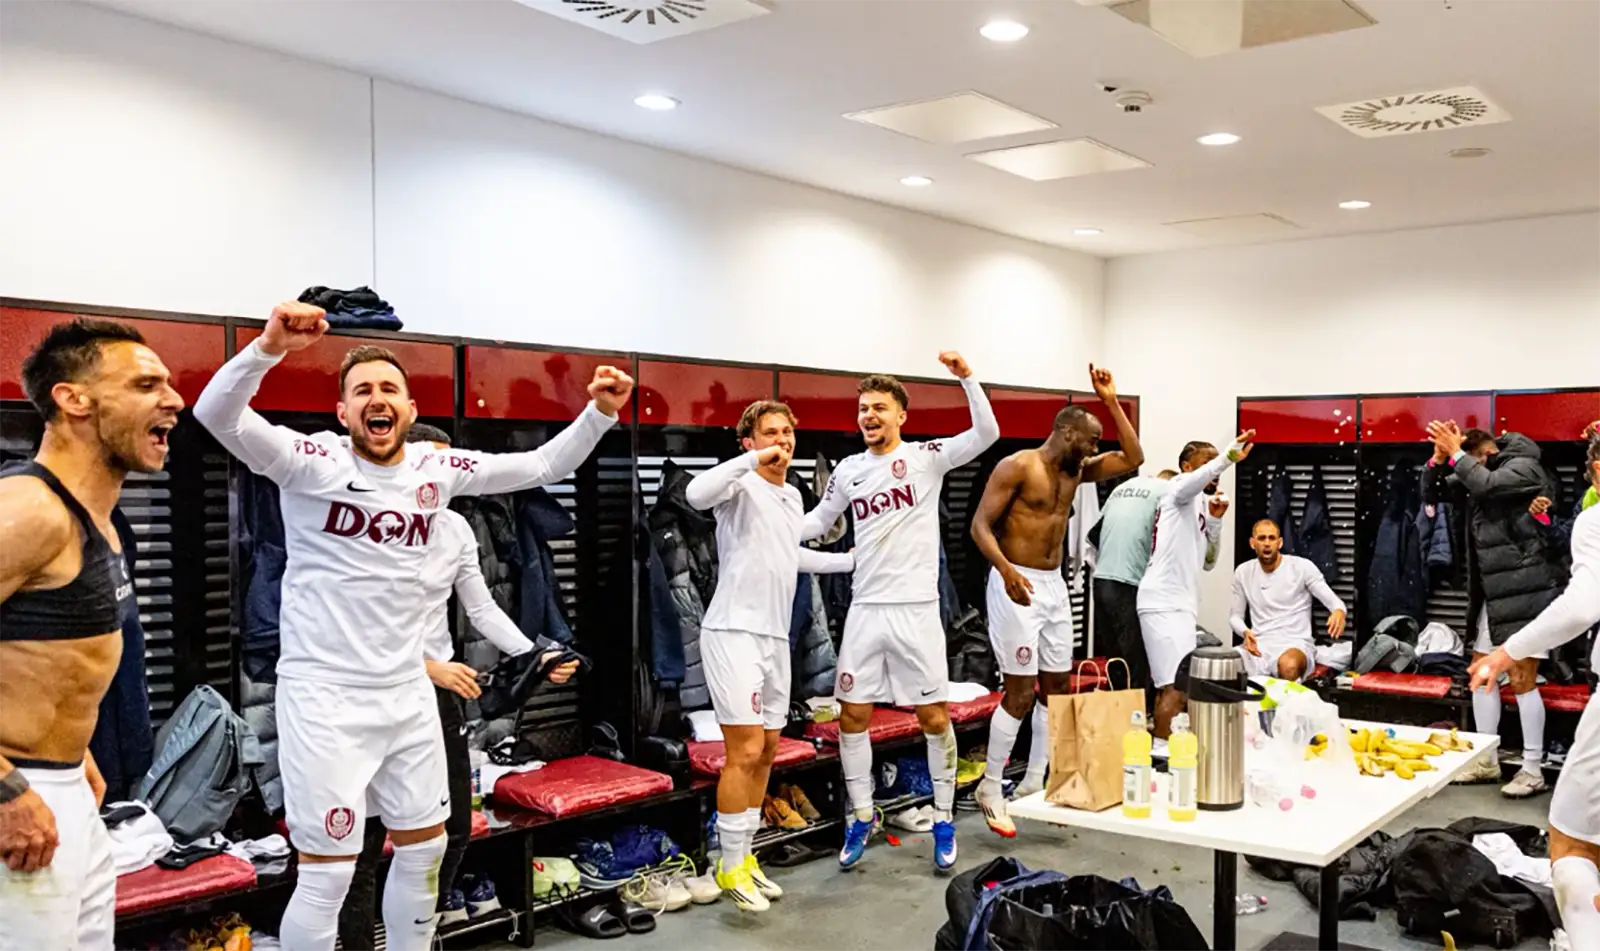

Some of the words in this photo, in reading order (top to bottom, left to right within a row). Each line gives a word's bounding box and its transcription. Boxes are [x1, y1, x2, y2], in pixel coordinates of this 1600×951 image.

[852, 484, 916, 520] DON
[1123, 488, 1151, 499] CLUJ
[322, 500, 433, 547] DON
